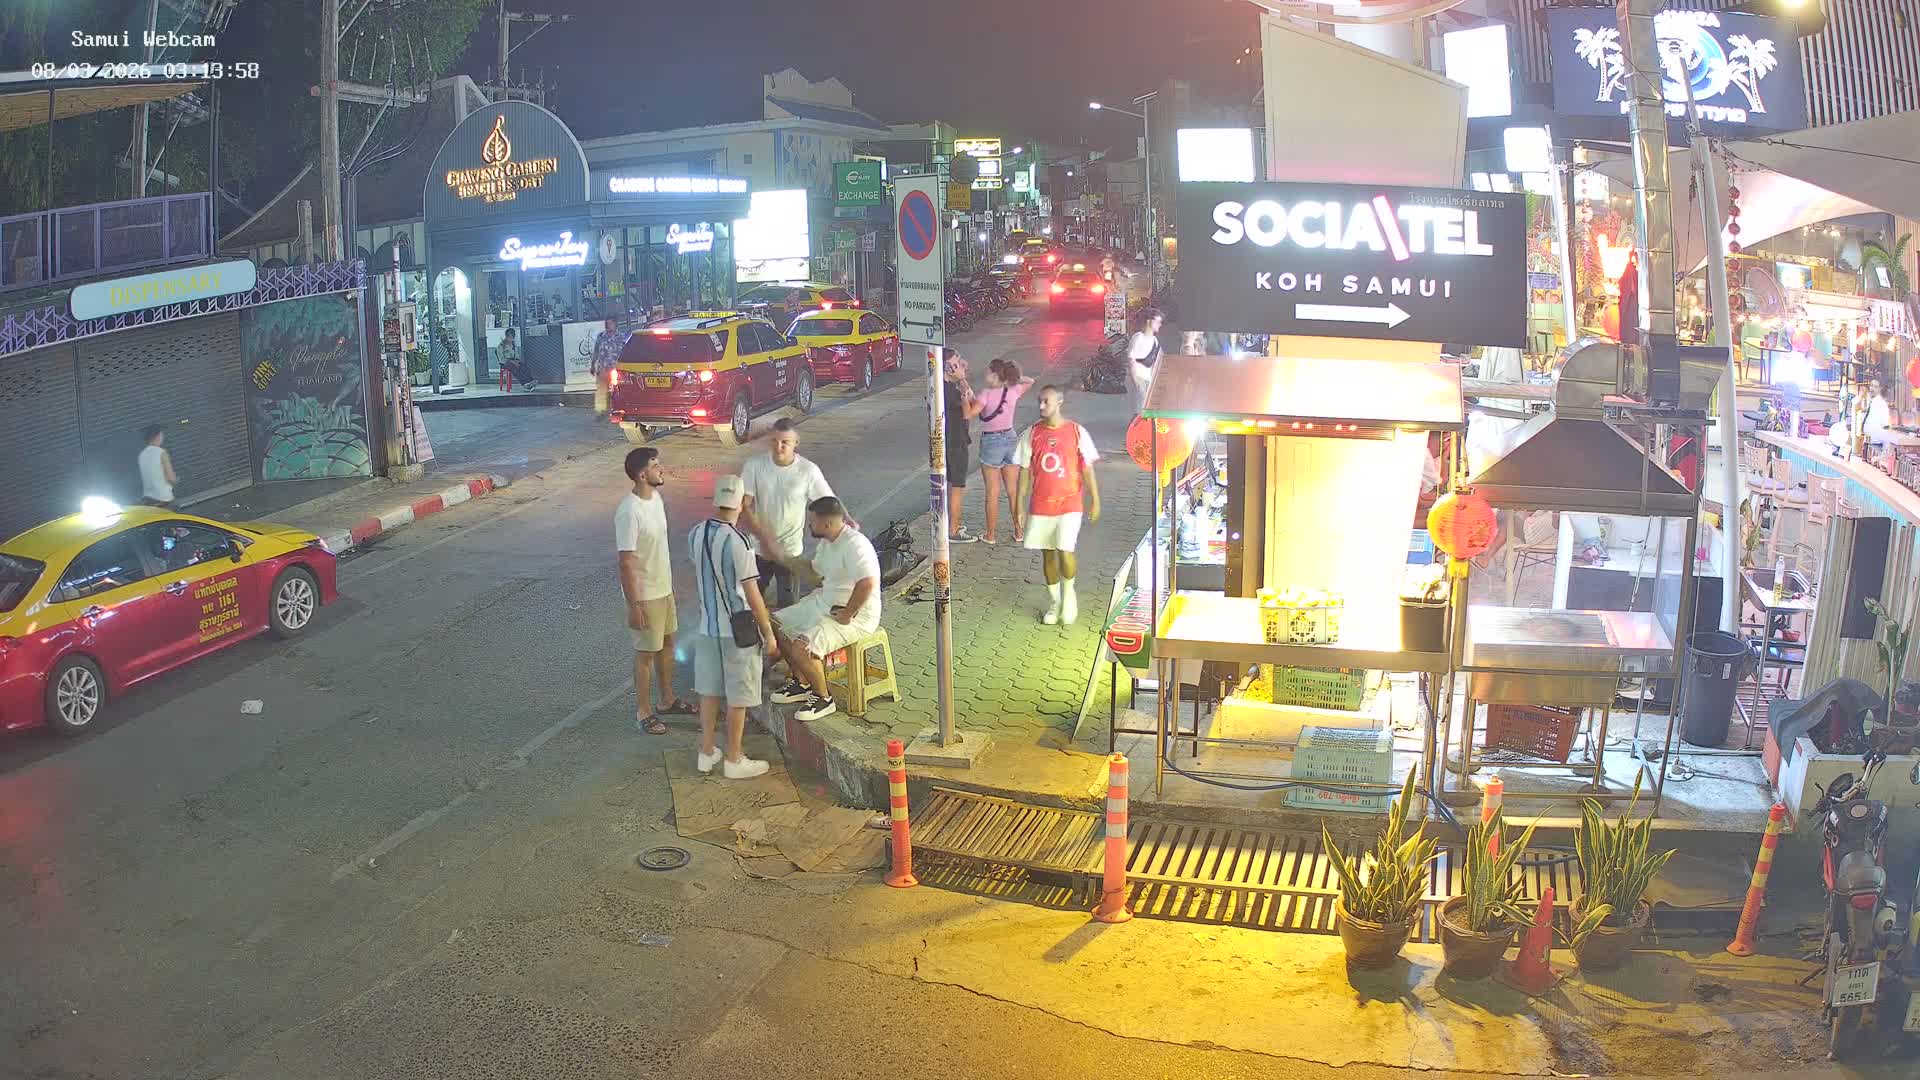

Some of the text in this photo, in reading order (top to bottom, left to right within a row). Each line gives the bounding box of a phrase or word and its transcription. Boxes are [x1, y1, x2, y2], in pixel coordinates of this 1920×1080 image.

[505, 158, 558, 177] GARDEN
[838, 191, 879, 200] EXCHANGE
[110, 271, 223, 308] DISPENSARY
[1256, 271, 1452, 299] KOH SAMUI
[904, 300, 936, 311] NO PARKING
[297, 375, 343, 386] THAILAND
